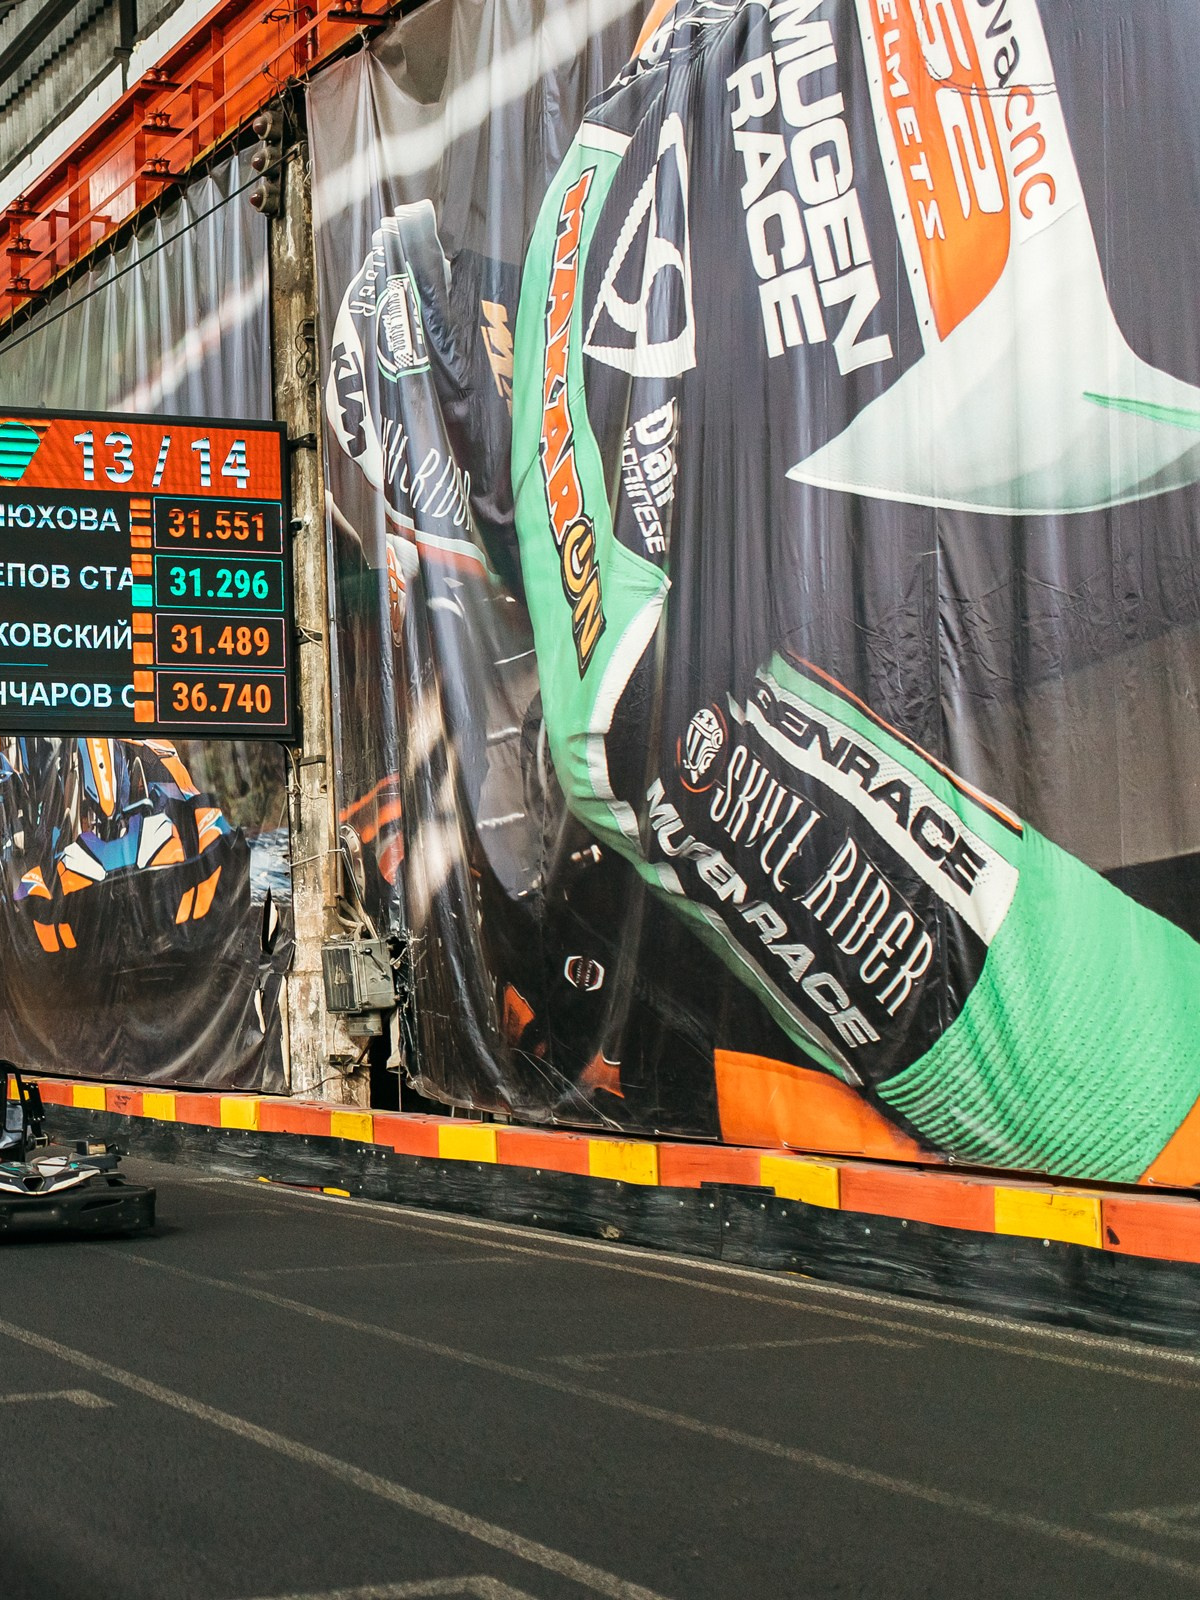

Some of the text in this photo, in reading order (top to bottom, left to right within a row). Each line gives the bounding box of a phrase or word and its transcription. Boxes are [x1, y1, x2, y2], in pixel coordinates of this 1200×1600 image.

[726, 52, 827, 358] RACE
[768, 0, 893, 376] MUGEN
[332, 341, 368, 459] KTM
[73, 429, 251, 489] 13 / 14
[622, 447, 666, 554] DAINESE
[168, 508, 264, 542] 31.551
[169, 566, 269, 600] 31.296
[171, 624, 270, 656] 31.489
[172, 681, 272, 714] 36.740
[709, 744, 933, 1017] SKULL RIDER
